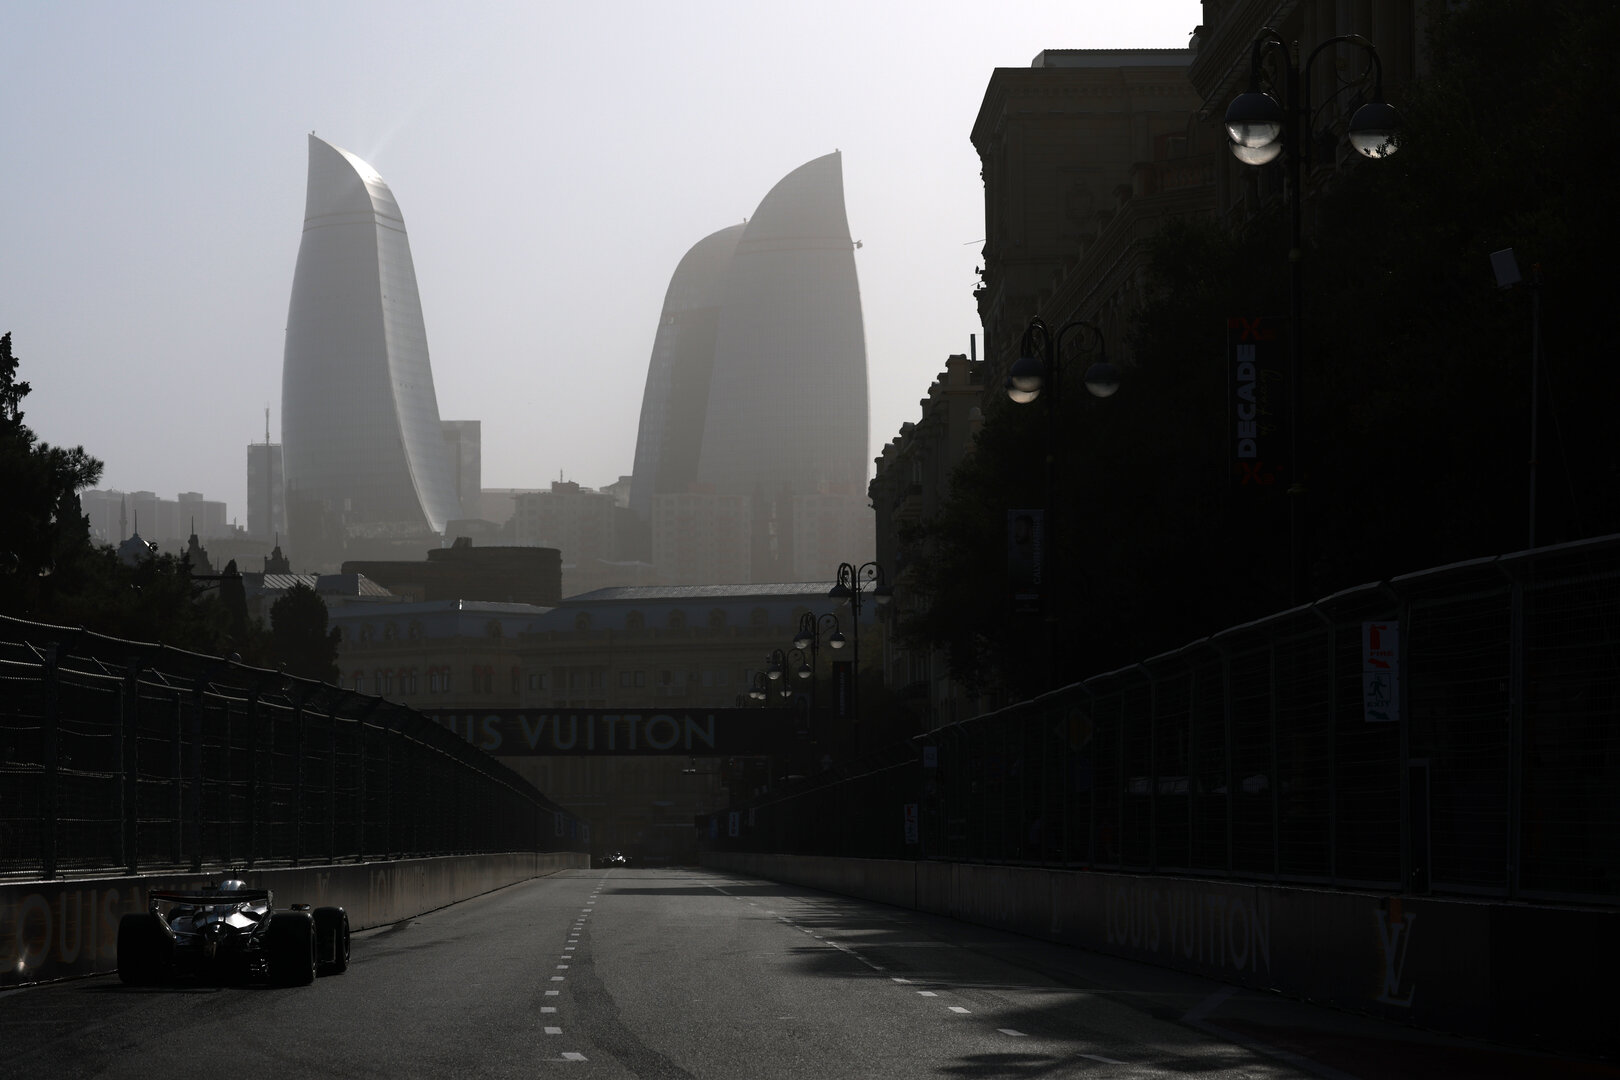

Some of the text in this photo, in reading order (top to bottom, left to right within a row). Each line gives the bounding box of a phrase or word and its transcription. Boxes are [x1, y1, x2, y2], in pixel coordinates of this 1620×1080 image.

[1236, 344, 1257, 458] DECADE
[517, 714, 716, 750] VUITTON
[1367, 700, 1390, 708] EXIT
[1105, 885, 1160, 952] LOUIS
[1167, 889, 1272, 977] VUITTON
